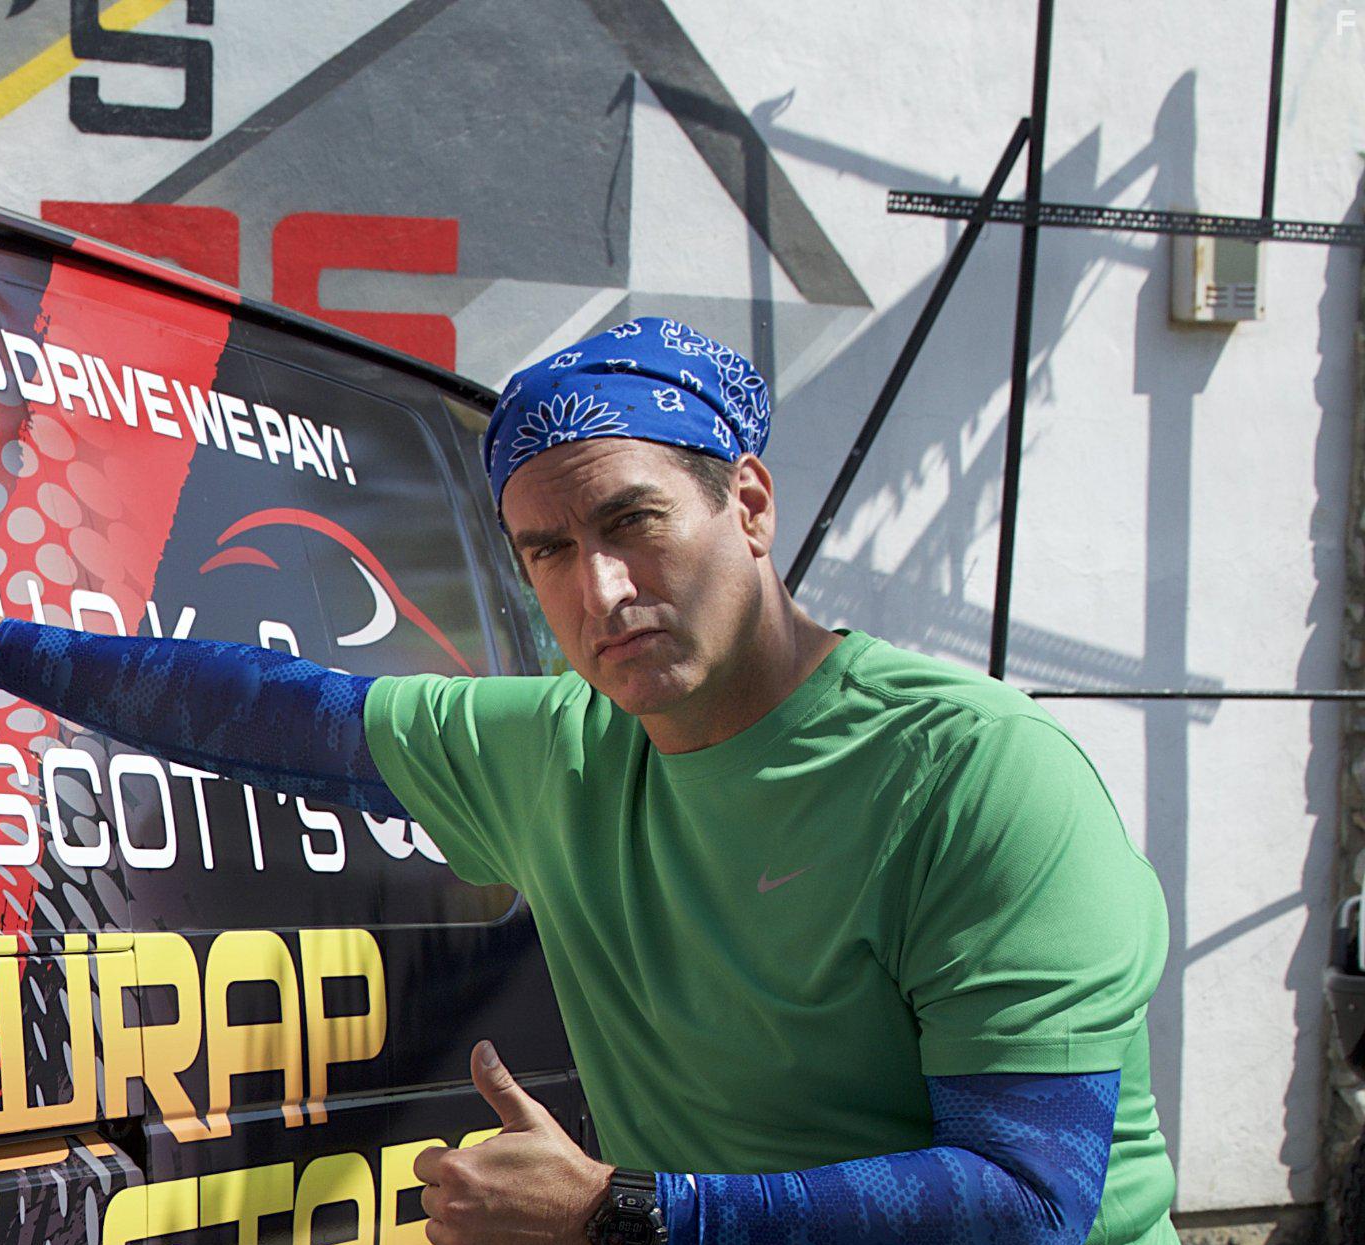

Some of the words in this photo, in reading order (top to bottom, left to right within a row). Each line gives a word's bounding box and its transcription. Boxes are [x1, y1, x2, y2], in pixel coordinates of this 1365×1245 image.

[1, 328, 183, 440] DRIVE
[171, 379, 263, 460] WE
[253, 403, 357, 486] PAY!
